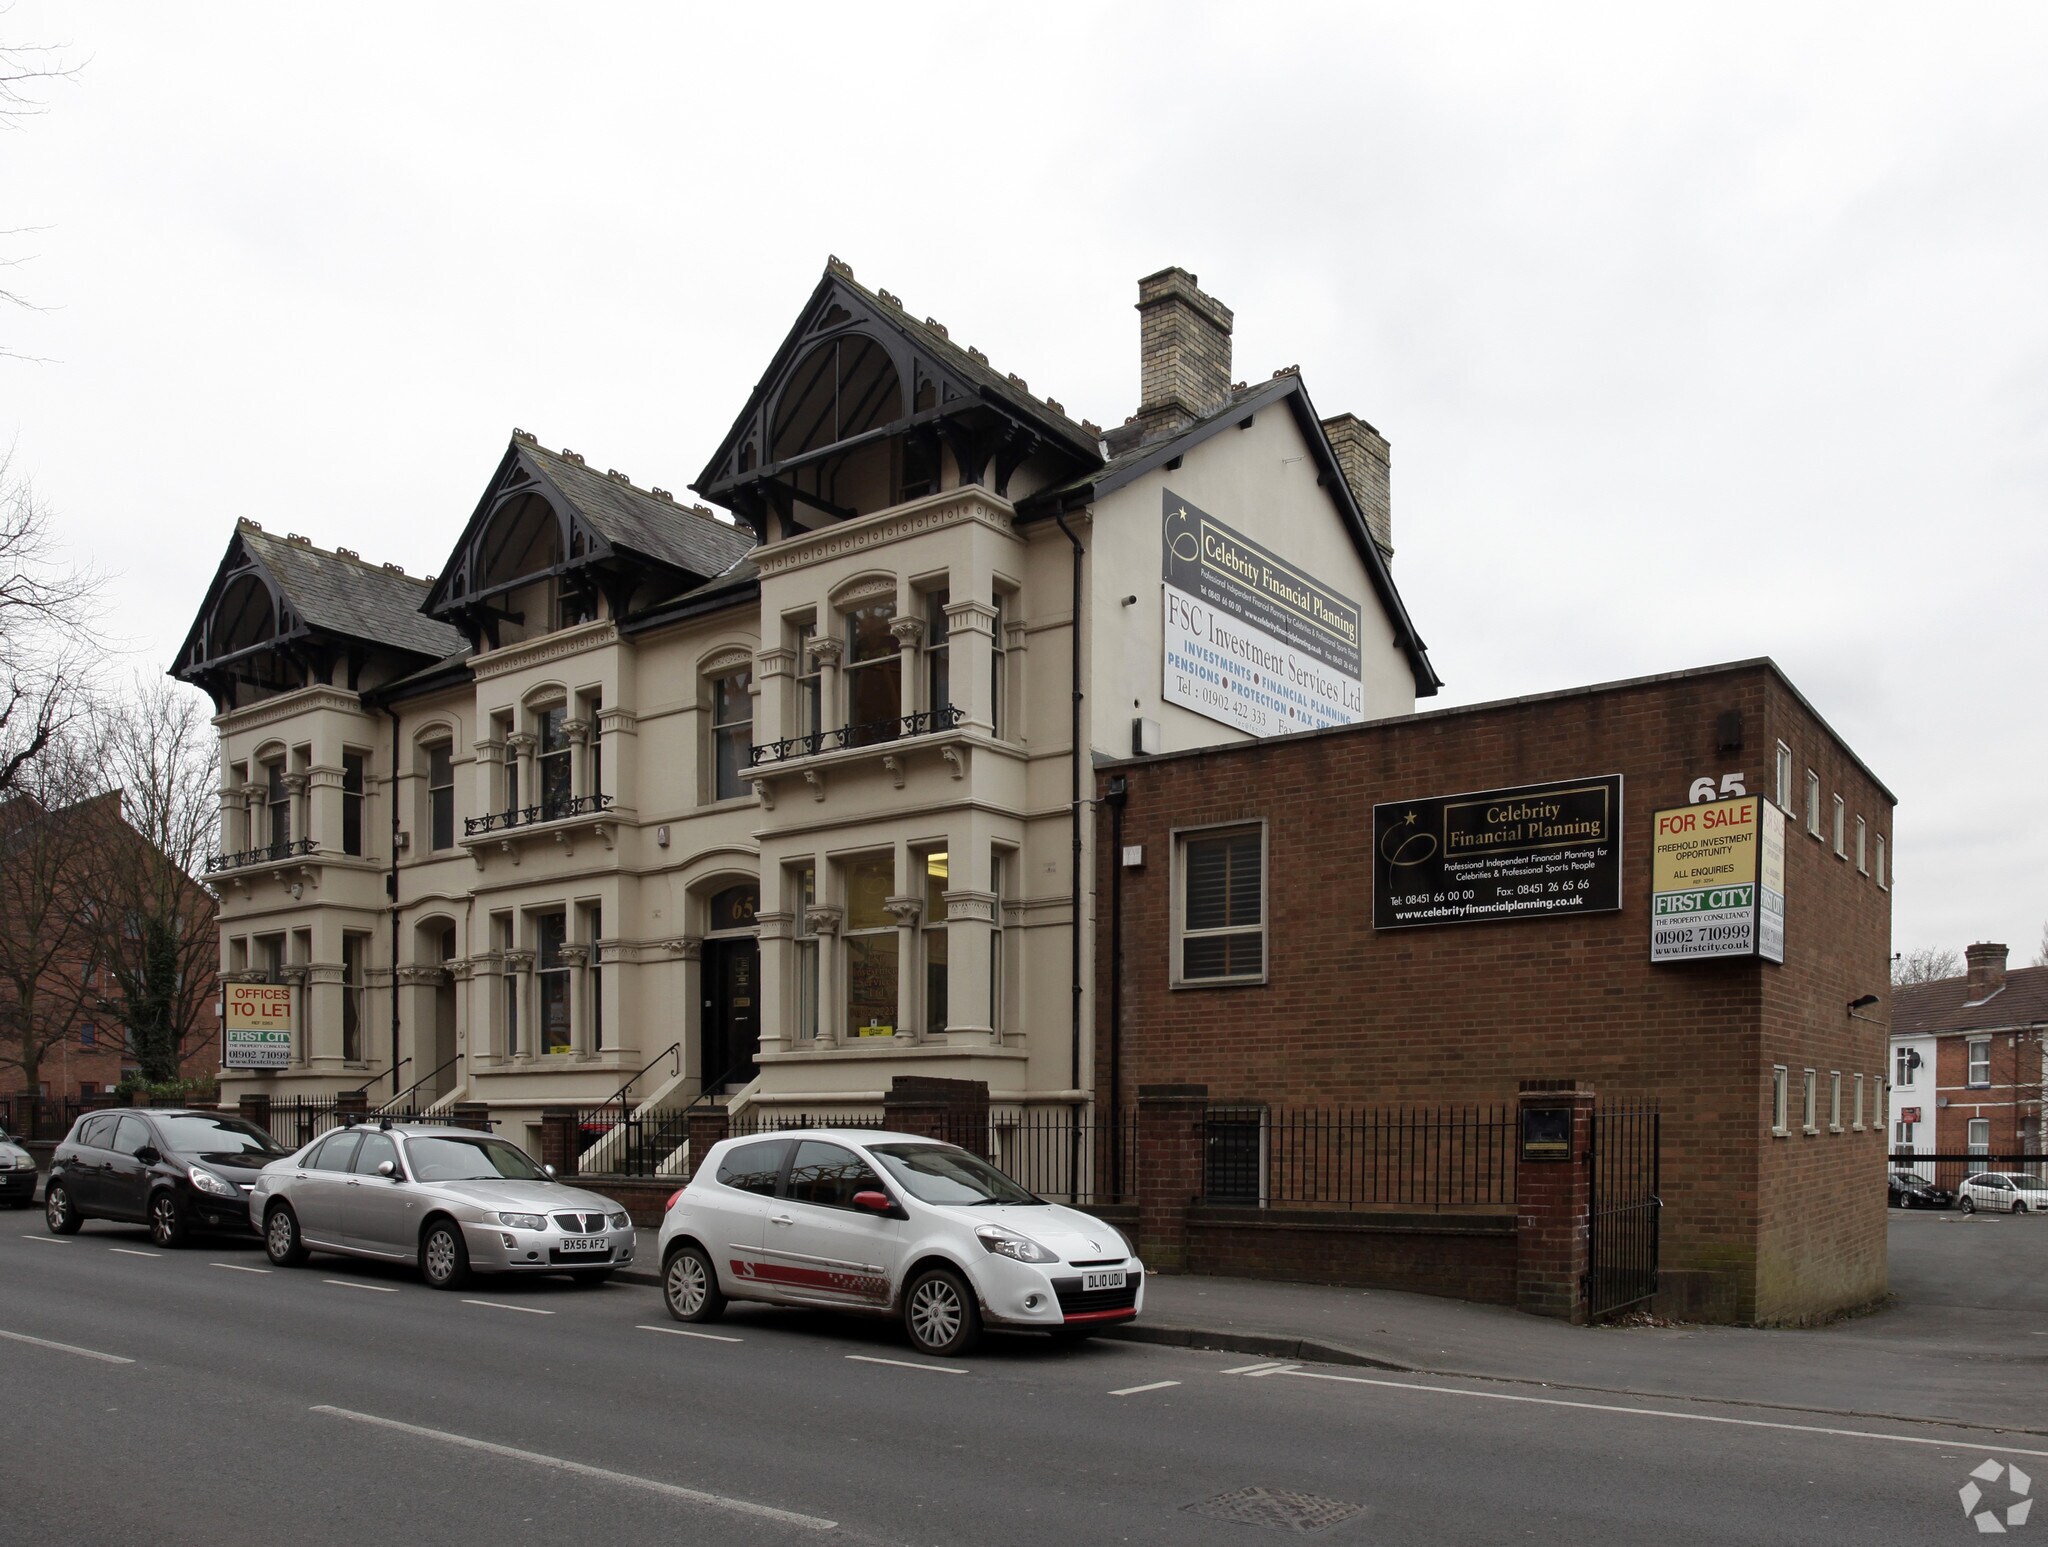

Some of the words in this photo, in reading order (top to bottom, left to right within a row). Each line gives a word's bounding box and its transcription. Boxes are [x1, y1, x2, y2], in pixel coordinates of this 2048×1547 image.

[1200, 568, 1226, 588] Professional
[1252, 596, 1270, 612] Financial
[1205, 535, 1259, 586] Celebrity
[1262, 566, 1310, 612] Financial
[1313, 596, 1355, 641] Planning
[1168, 592, 1203, 636] FSC
[1208, 612, 1284, 676] Investment
[1288, 653, 1339, 702] Services
[1342, 680, 1361, 713] Ltd
[1168, 652, 1220, 686] PENSIONS
[1231, 680, 1286, 715] PROTECTION
[1296, 709, 1312, 726] TAX
[1184, 640, 1251, 681] INVESTMENTS
[1262, 676, 1308, 707] FINANCIAL
[1310, 698, 1351, 724] PLANNING
[1202, 687, 1229, 711] 01902
[1232, 700, 1248, 719] 422
[1251, 708, 1266, 727] 333
[1278, 718, 1294, 735] Fax
[1689, 773, 1746, 804] 65
[1487, 801, 1561, 824] Celebrity
[1660, 814, 1696, 836] FOR
[1702, 805, 1752, 830] SALE
[1450, 824, 1522, 848] Financial
[1528, 818, 1601, 839] Planning
[1658, 840, 1698, 854] FREEHOLD
[1700, 832, 1753, 848] INVESTMENT
[1444, 860, 1484, 872] Professional
[1486, 856, 1528, 868] Independent
[1531, 852, 1562, 862] Financial
[1564, 850, 1595, 860] Planning
[1597, 848, 1608, 856] for
[1676, 846, 1732, 860] OPPORTUNITY
[1456, 870, 1492, 881] Celebrities
[1494, 870, 1500, 878] &
[1502, 864, 1544, 876] Professional
[1545, 863, 1569, 874] Sports
[1571, 860, 1596, 870] People
[1674, 870, 1688, 879] ALL
[1691, 864, 1735, 877] ENQUIRIES
[1390, 896, 1402, 906] Tel:
[1405, 893, 1430, 905] 08451
[1434, 892, 1445, 902] 66
[1448, 890, 1460, 901] 00
[1462, 890, 1475, 900] 00
[1496, 887, 1514, 897] Fax:
[1517, 883, 1543, 895] 08451
[1548, 882, 1559, 892] 26
[1562, 880, 1574, 891] 65
[1577, 878, 1590, 890] 66
[732, 896, 754, 920] 65
[1396, 894, 1583, 920] www.celebrityfinancialplanning.co.uk
[1656, 892, 1705, 914] FIRST
[1708, 888, 1750, 908] CITY
[1670, 916, 1702, 925] PROPERTY
[1704, 910, 1750, 922] CONSULTANCY
[1655, 930, 1693, 946] 01902
[1698, 924, 1750, 941] 710999
[1655, 940, 1750, 955] www.firstcity.co.uk
[236, 988, 290, 1000] OFFICES
[230, 1002, 256, 1016] TO
[262, 1003, 290, 1018] LET
[230, 1032, 264, 1041] FIRST
[229, 1050, 256, 1059] 01902
[260, 1051, 291, 1060] 71099
[563, 1240, 588, 1250] BX56
[590, 1239, 605, 1249] AFZ
[1088, 1274, 1107, 1288] DL10
[1108, 1272, 1122, 1286] UDU
